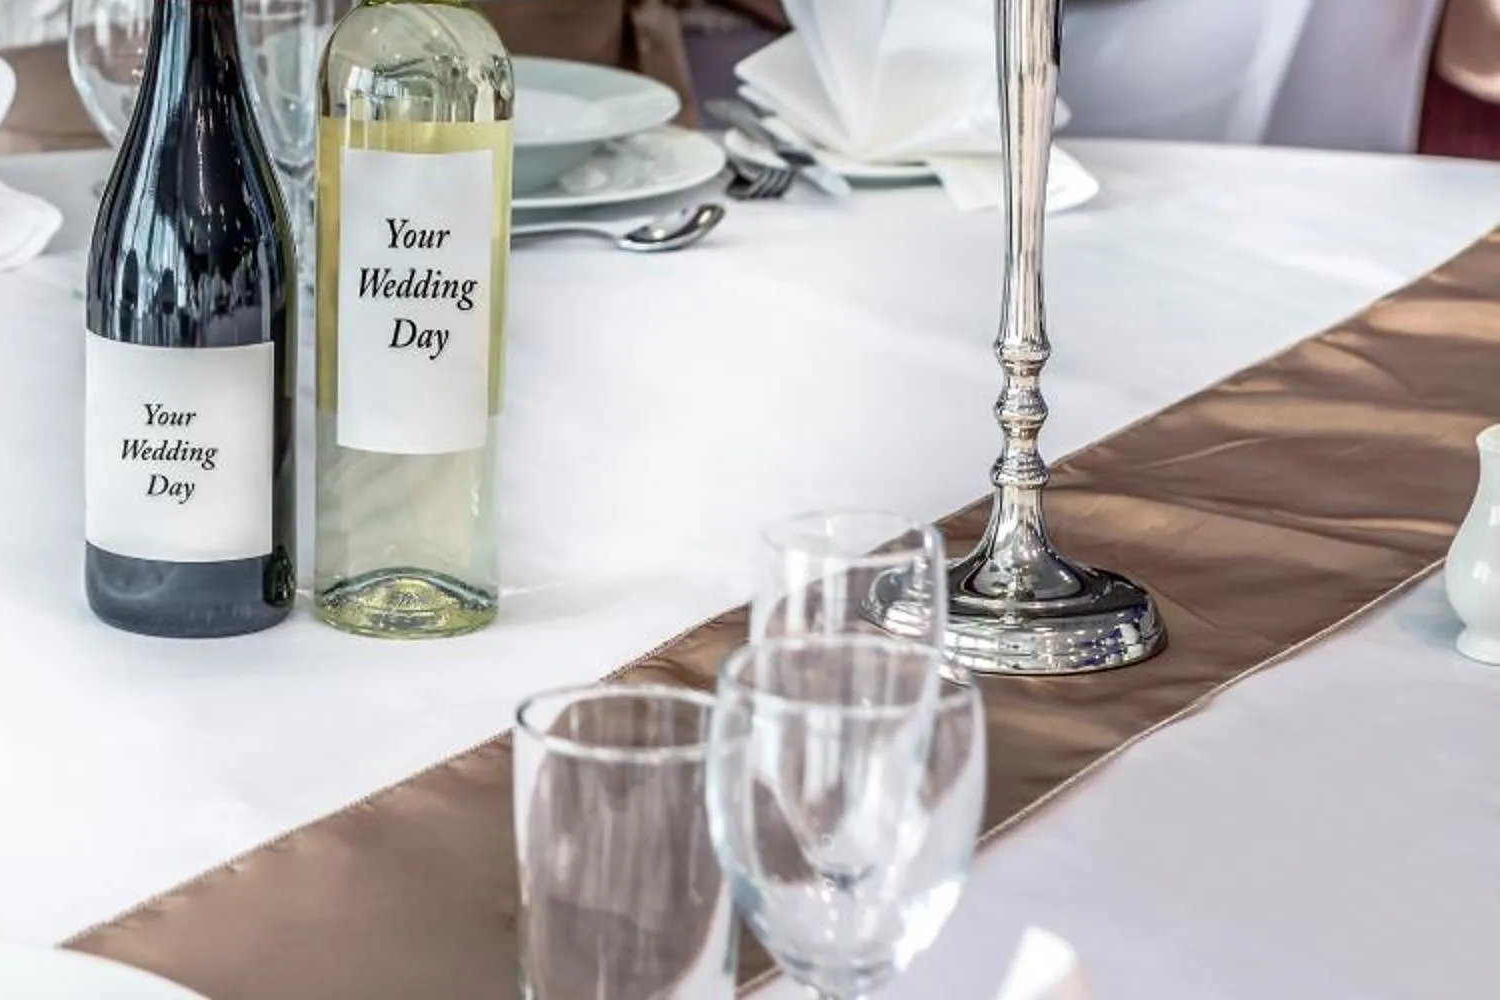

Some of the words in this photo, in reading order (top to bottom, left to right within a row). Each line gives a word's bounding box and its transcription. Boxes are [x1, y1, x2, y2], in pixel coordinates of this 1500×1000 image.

[385, 217, 451, 249] Your
[357, 267, 479, 311] Wedding
[388, 318, 450, 361] Day
[143, 403, 197, 426] Your
[120, 439, 218, 470] Wedding
[146, 474, 196, 505] Day
